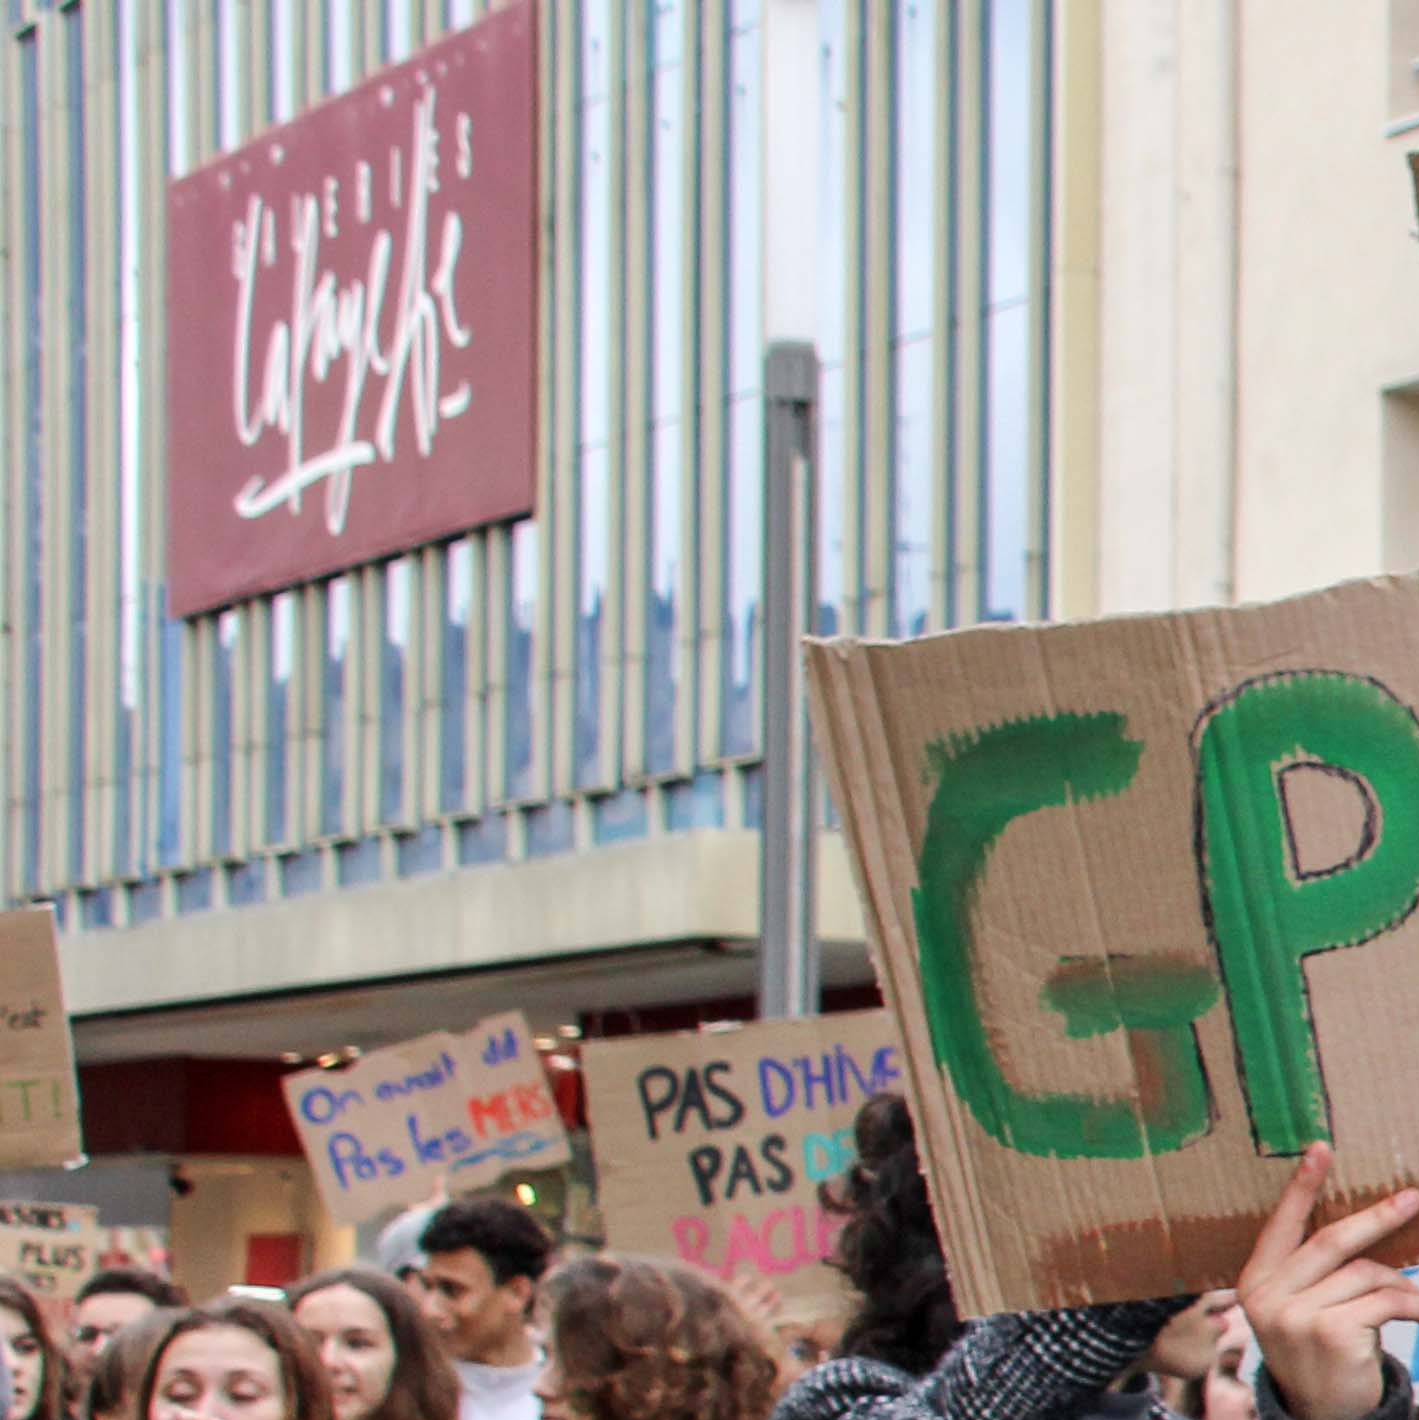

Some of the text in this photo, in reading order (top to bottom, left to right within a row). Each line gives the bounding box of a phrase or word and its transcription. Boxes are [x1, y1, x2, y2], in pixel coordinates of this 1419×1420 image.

[301, 1086, 365, 1125] On
[636, 1043, 902, 1140] PAS D'HIVE
[327, 1132, 405, 1189] Pas
[407, 1113, 472, 1164] les
[688, 1133, 795, 1207] PAS
